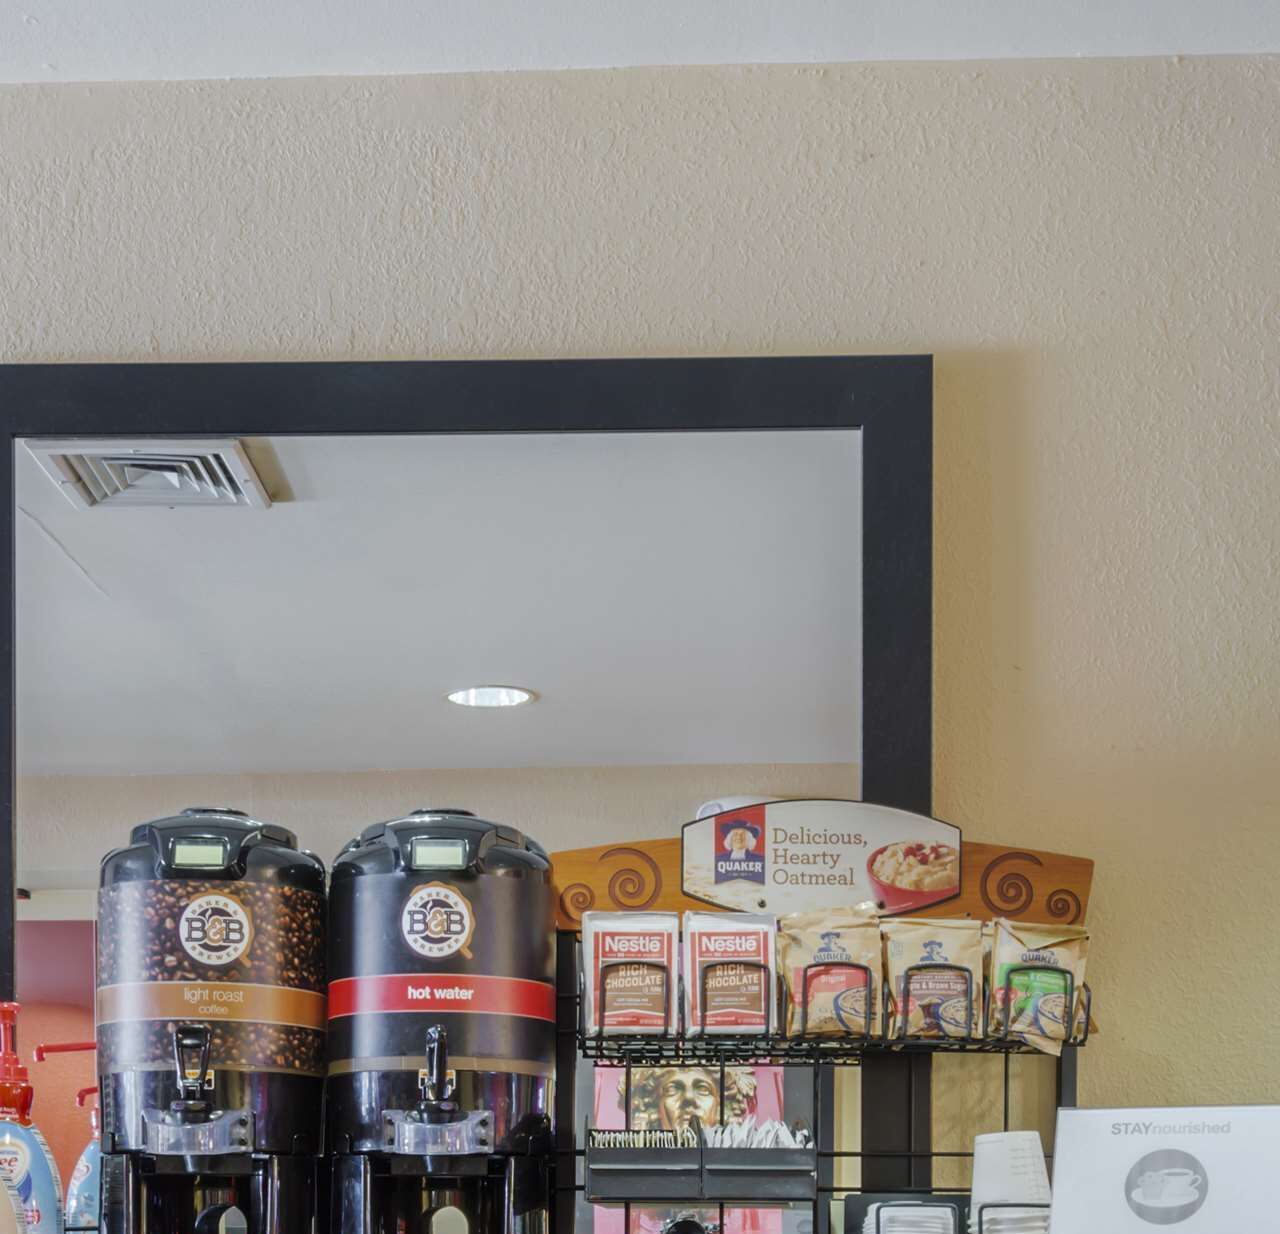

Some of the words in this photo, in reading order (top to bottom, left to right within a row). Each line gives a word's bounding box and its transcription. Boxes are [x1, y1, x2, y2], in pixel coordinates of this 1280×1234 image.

[773, 827, 868, 848] Delicious,
[773, 848, 841, 868] Hearty
[717, 860, 762, 874] QUAKER
[773, 868, 855, 886] Oatmeal
[184, 914, 245, 944] B&B
[407, 907, 466, 937] B&B
[619, 964, 648, 977] RICH
[716, 964, 745, 977] RICH
[183, 986, 209, 1004] light
[212, 989, 244, 1002] roast
[407, 985, 431, 1000] hot
[434, 986, 474, 1000] water
[199, 1003, 229, 1015] coffee
[1110, 1121, 1231, 1136] STAYnourished
